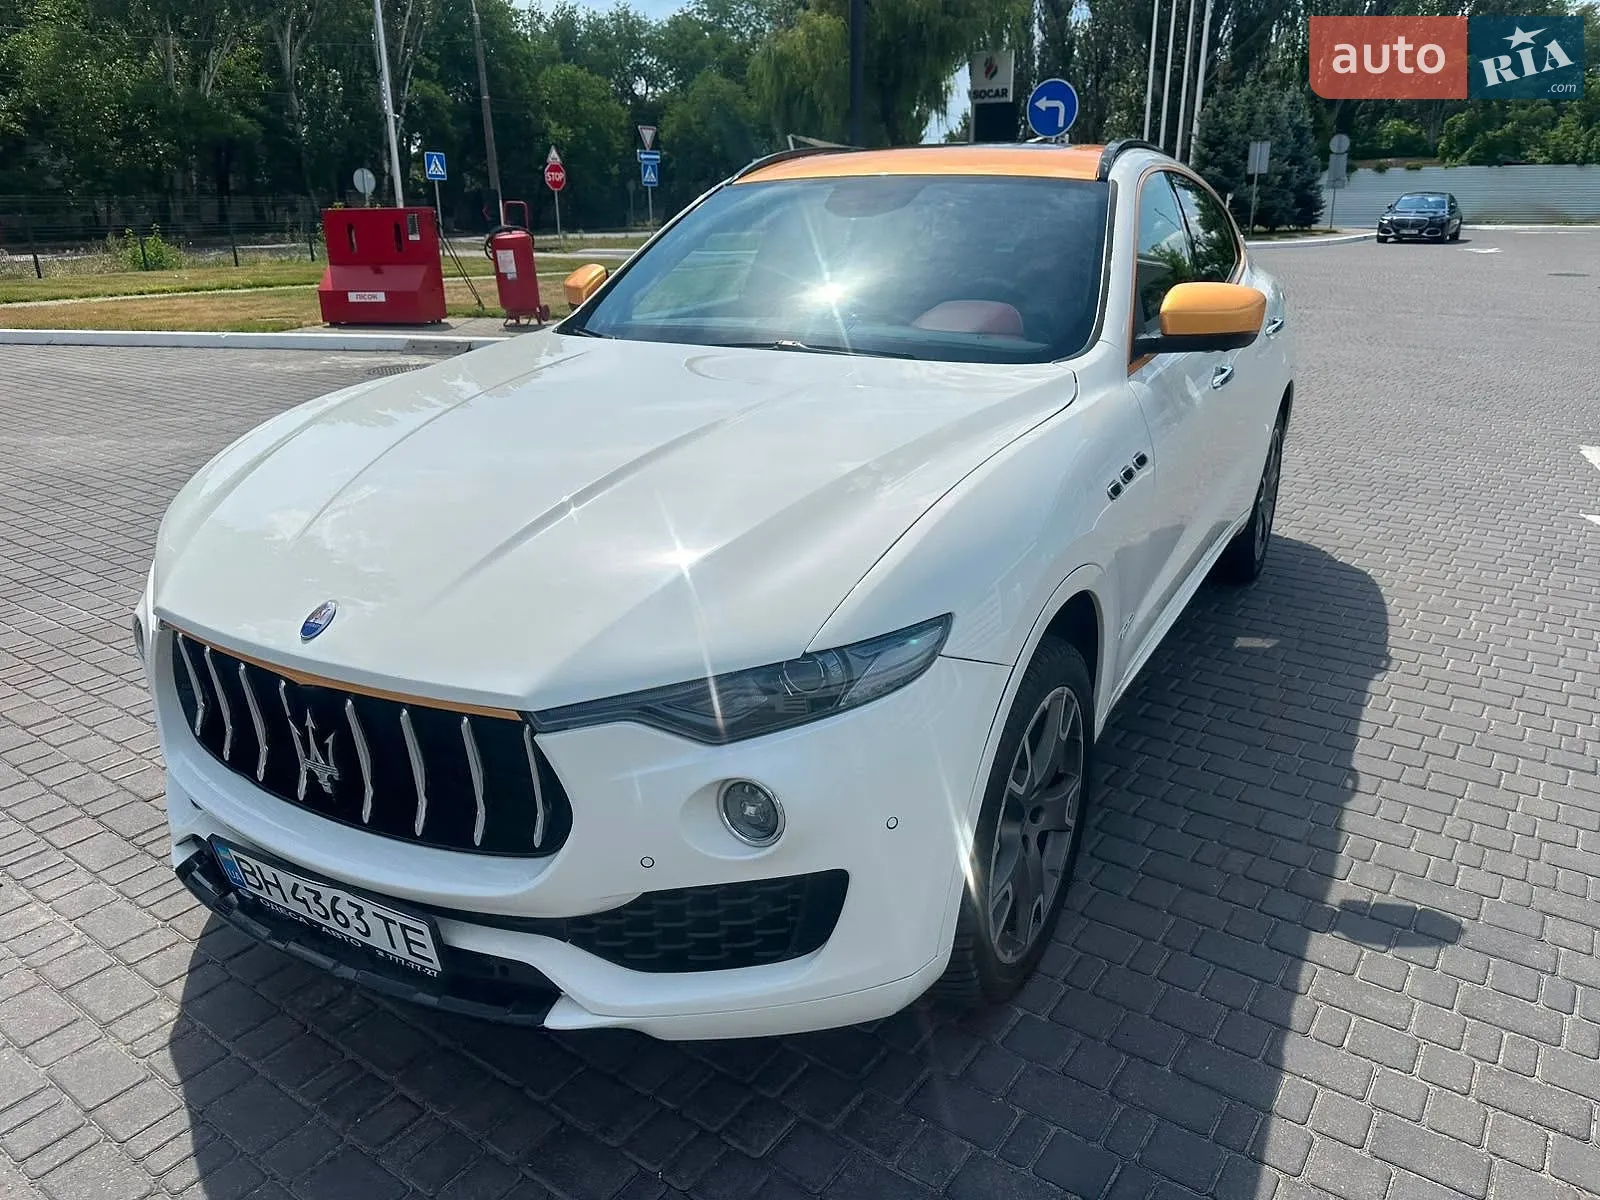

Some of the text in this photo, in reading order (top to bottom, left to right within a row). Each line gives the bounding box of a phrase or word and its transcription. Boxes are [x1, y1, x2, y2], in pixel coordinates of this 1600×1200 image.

[972, 88, 1009, 99] SOCAR
[546, 172, 565, 182] STOP
[291, 882, 372, 938] 4363
